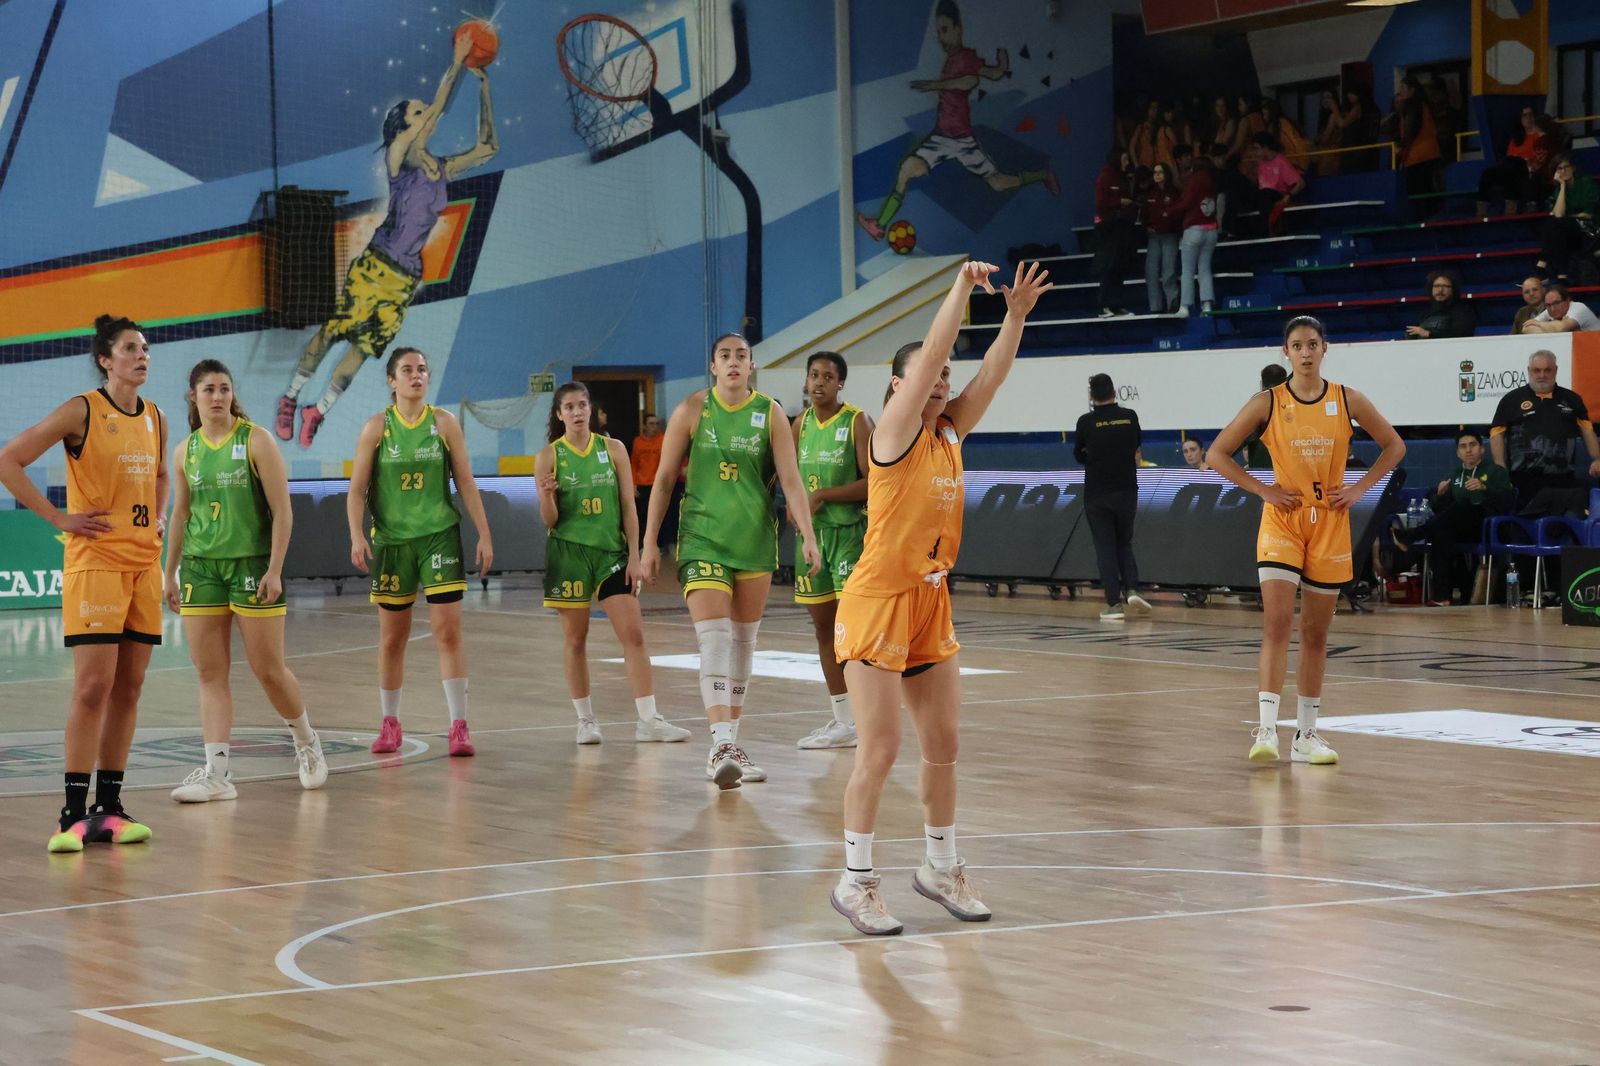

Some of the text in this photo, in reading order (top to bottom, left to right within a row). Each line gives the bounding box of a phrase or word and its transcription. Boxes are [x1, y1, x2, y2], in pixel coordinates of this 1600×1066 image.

[1477, 370, 1528, 390] ZAMORA
[1116, 385, 1139, 401] ORA
[1301, 446, 1325, 456] salud
[400, 472, 424, 491] 23
[1312, 481, 1323, 500] 5
[209, 500, 221, 521] 7
[581, 496, 602, 516] 30
[132, 504, 149, 528] 28
[379, 574, 400, 592] 23
[561, 580, 584, 598] 30
[184, 583, 193, 603] 7
[713, 681, 726, 691] 622
[732, 686, 746, 695] 622
